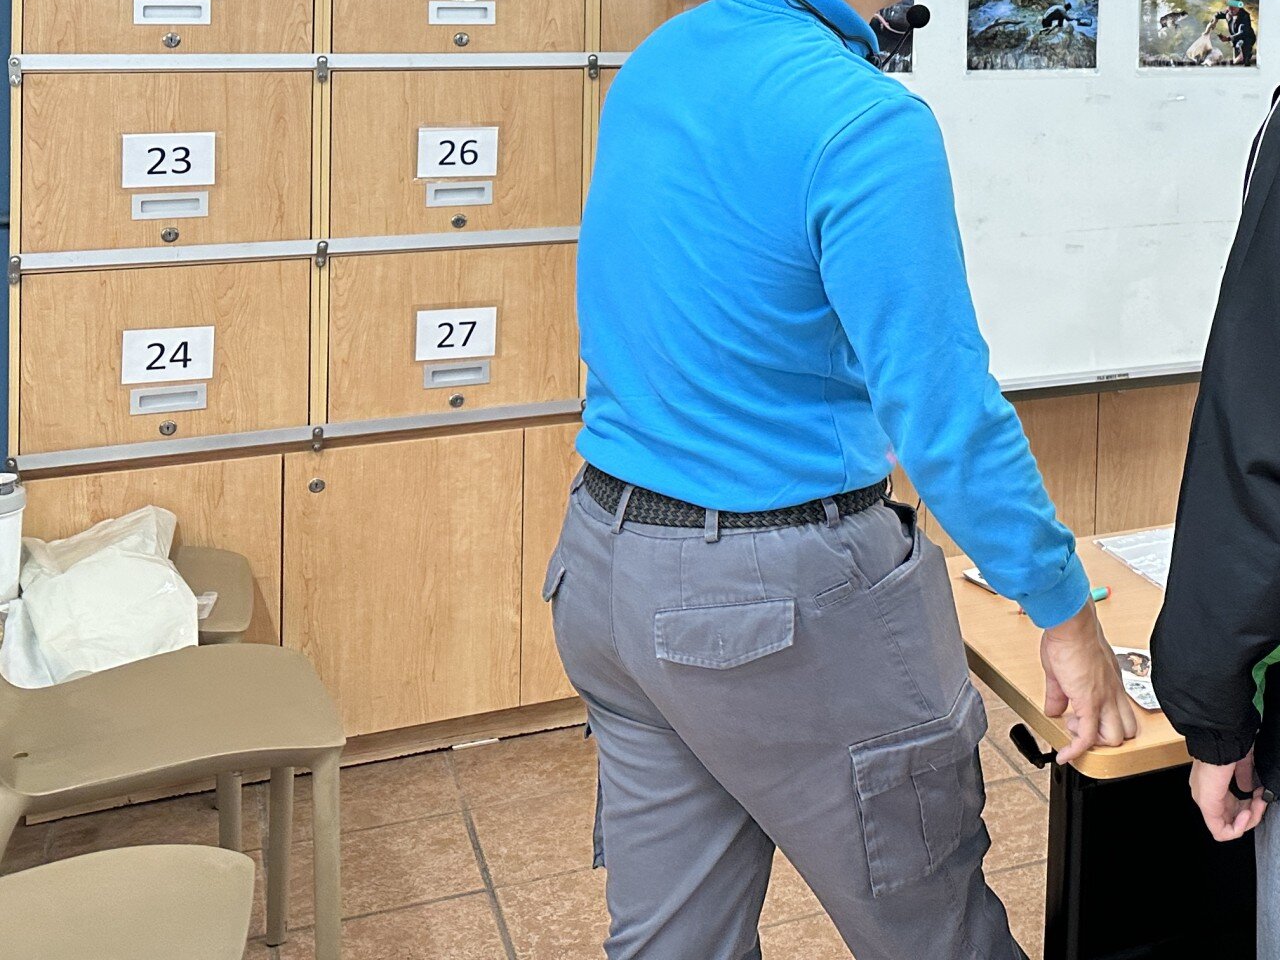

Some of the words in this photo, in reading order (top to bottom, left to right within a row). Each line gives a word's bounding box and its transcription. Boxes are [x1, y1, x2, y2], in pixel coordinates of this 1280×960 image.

[146, 146, 192, 175] 23
[438, 139, 478, 166] 26
[437, 321, 477, 349] 27
[145, 341, 192, 371] 24
